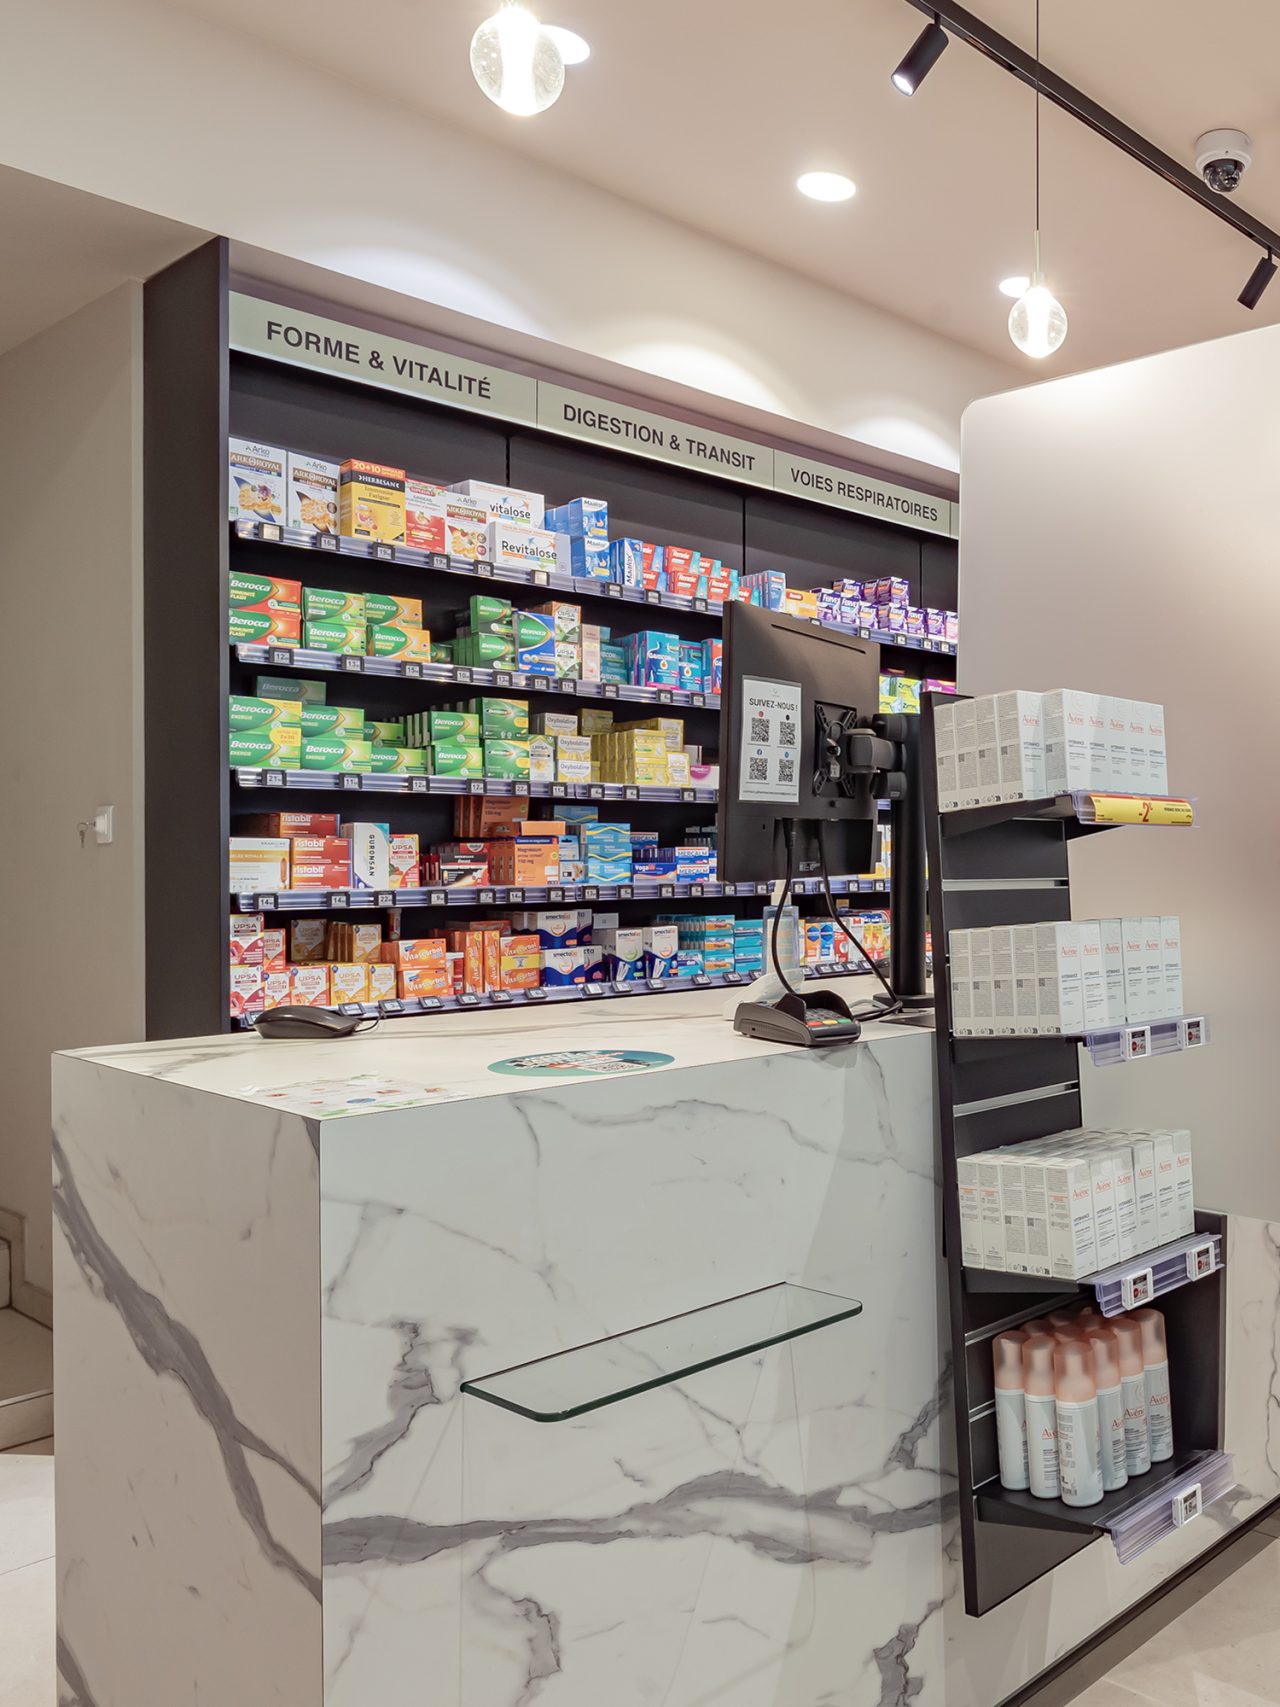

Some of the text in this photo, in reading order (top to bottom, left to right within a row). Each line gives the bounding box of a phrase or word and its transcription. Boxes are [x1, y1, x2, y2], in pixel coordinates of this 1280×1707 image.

[266, 320, 491, 399] FORME & VITALITÉ
[563, 404, 755, 471] DIGESTION & TRANSIT
[252, 446, 270, 456] Arko
[312, 462, 327, 472] Arko
[362, 475, 396, 488] HERBESAN
[790, 468, 938, 522] VOIES RESPIRATOIRES
[501, 540, 557, 560] Revitalose
[626, 554, 636, 585] Maalox
[230, 579, 272, 593] Berocca
[308, 594, 345, 606] Berocca
[366, 601, 397, 611] Berocca
[229, 616, 270, 629] Berocca
[309, 628, 346, 639] Berocca
[375, 633, 406, 643] Berocca
[262, 683, 300, 694] Berocca
[231, 703, 273, 715] Berocca
[748, 697, 795, 712] SUIVEZ-NOUS
[434, 718, 464, 727] Berocca
[547, 716, 576, 726] Oxyboldine
[230, 739, 272, 750] Berocca
[560, 739, 589, 748] Oxyboldine
[305, 745, 345, 755] Berocca
[438, 752, 467, 761] Berocca
[561, 763, 590, 771] Oxyboldine
[233, 922, 257, 930] UPSA
[403, 945, 443, 962] Vitascorbol
[234, 972, 257, 980] UPSA
[338, 972, 361, 980] UPSA
[407, 975, 446, 992] Vitascorbol
